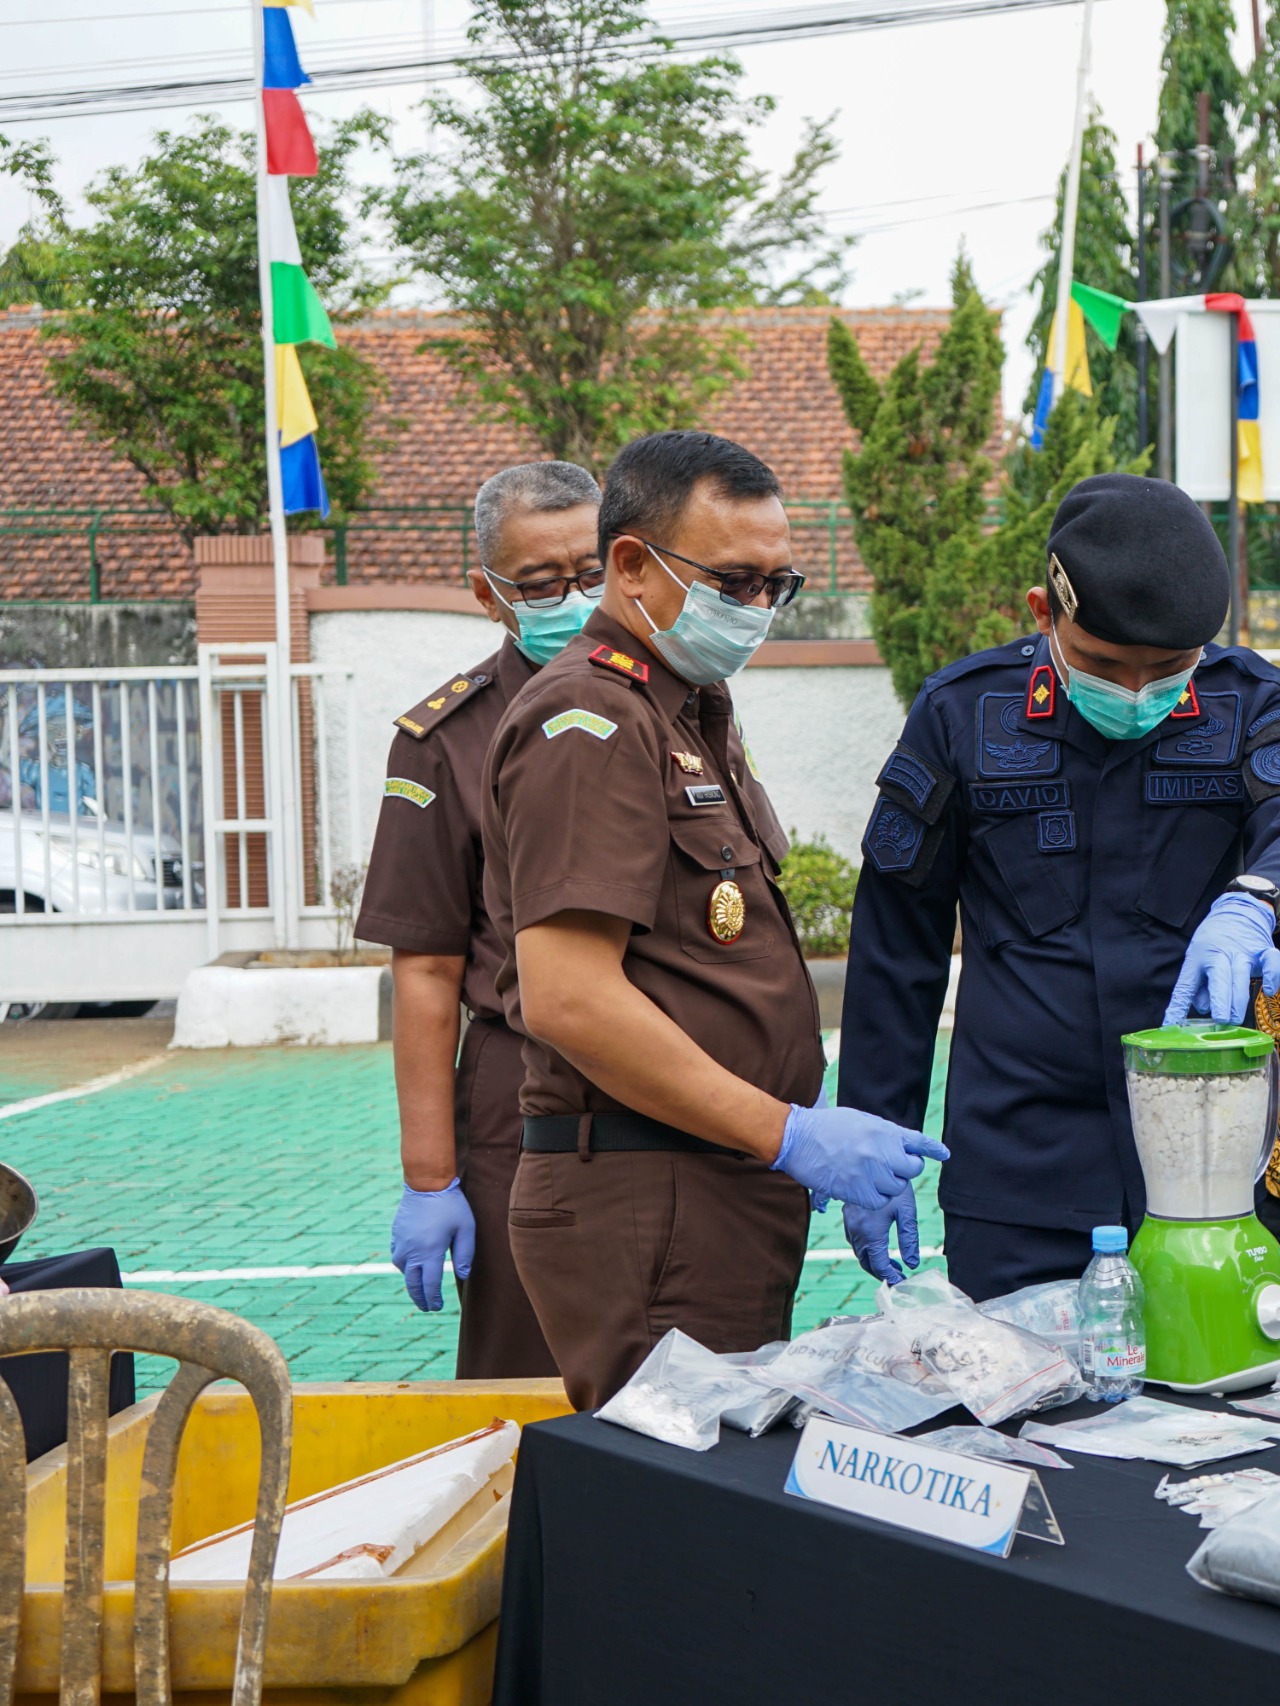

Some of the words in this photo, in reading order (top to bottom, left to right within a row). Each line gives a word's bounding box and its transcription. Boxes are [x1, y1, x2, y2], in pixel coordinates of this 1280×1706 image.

[979, 786, 1059, 808] DAVID
[1154, 776, 1239, 798] IMIPAS
[1127, 1344, 1138, 1356] Le
[817, 1440, 992, 1517] NARKOTIKA
